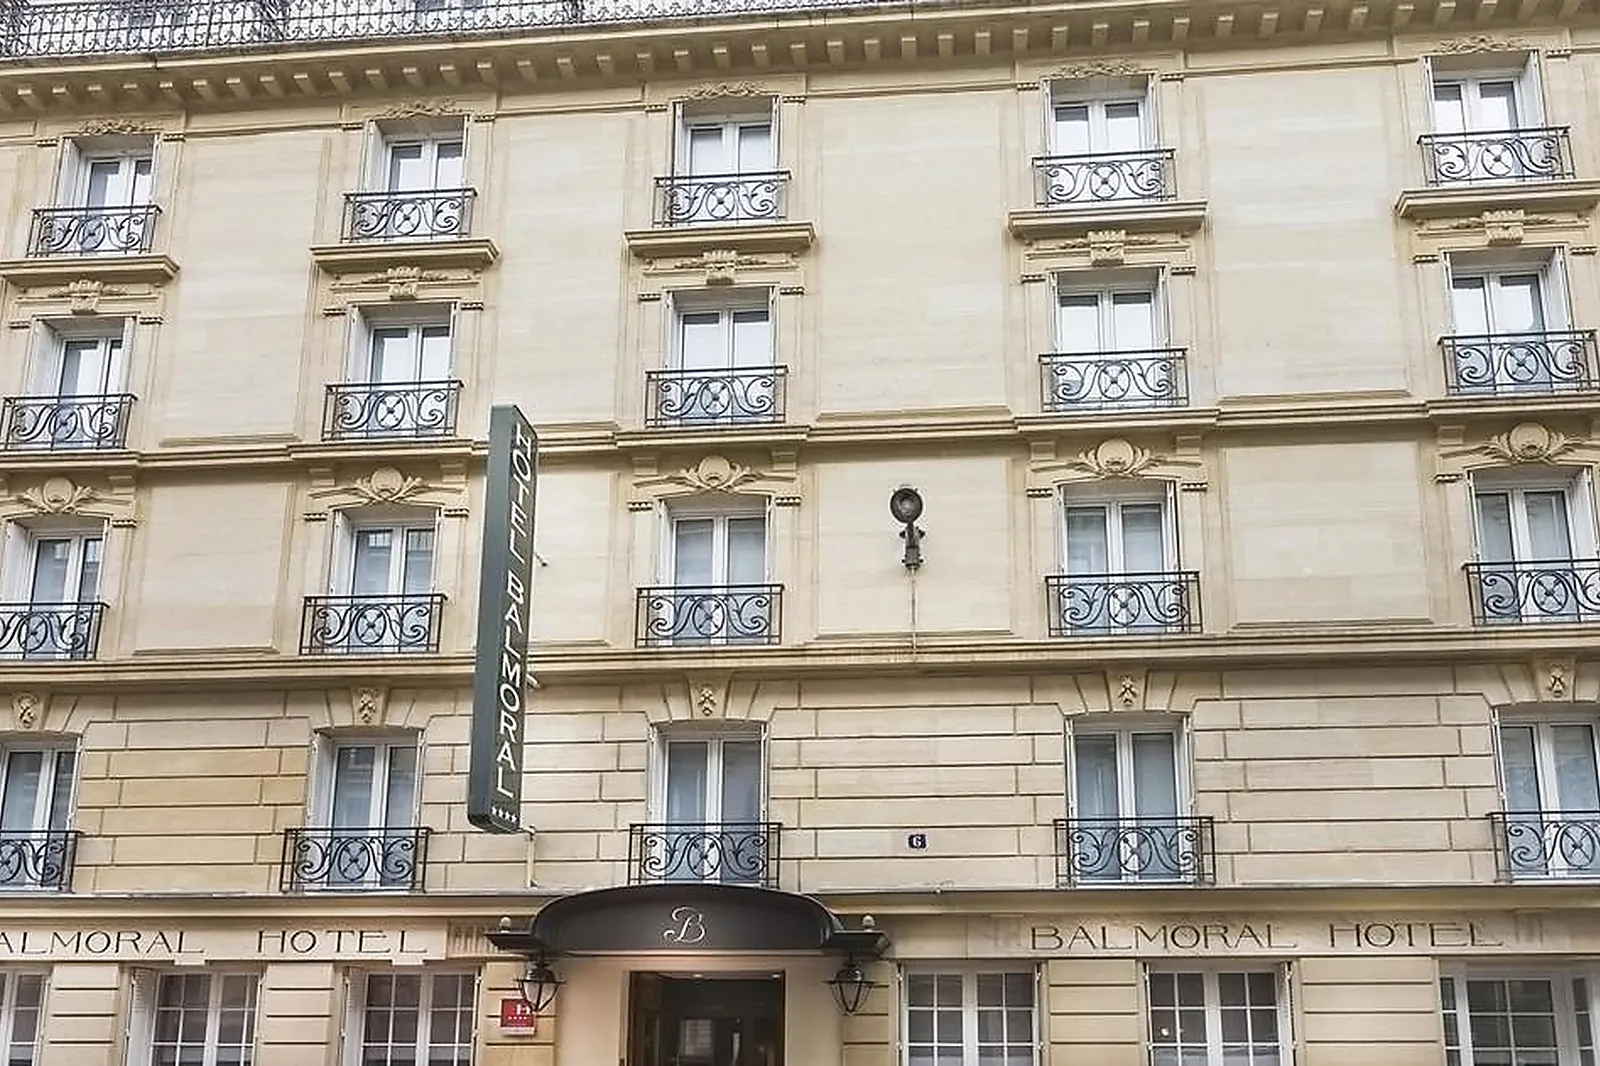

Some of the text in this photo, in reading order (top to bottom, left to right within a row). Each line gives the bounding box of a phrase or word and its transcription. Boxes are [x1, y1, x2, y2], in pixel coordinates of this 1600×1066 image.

[496, 422, 532, 799] HOTEL BALMORAL
[256, 929, 428, 954] HOTEL
[1030, 922, 1504, 951] BALMORAL HOTEL
